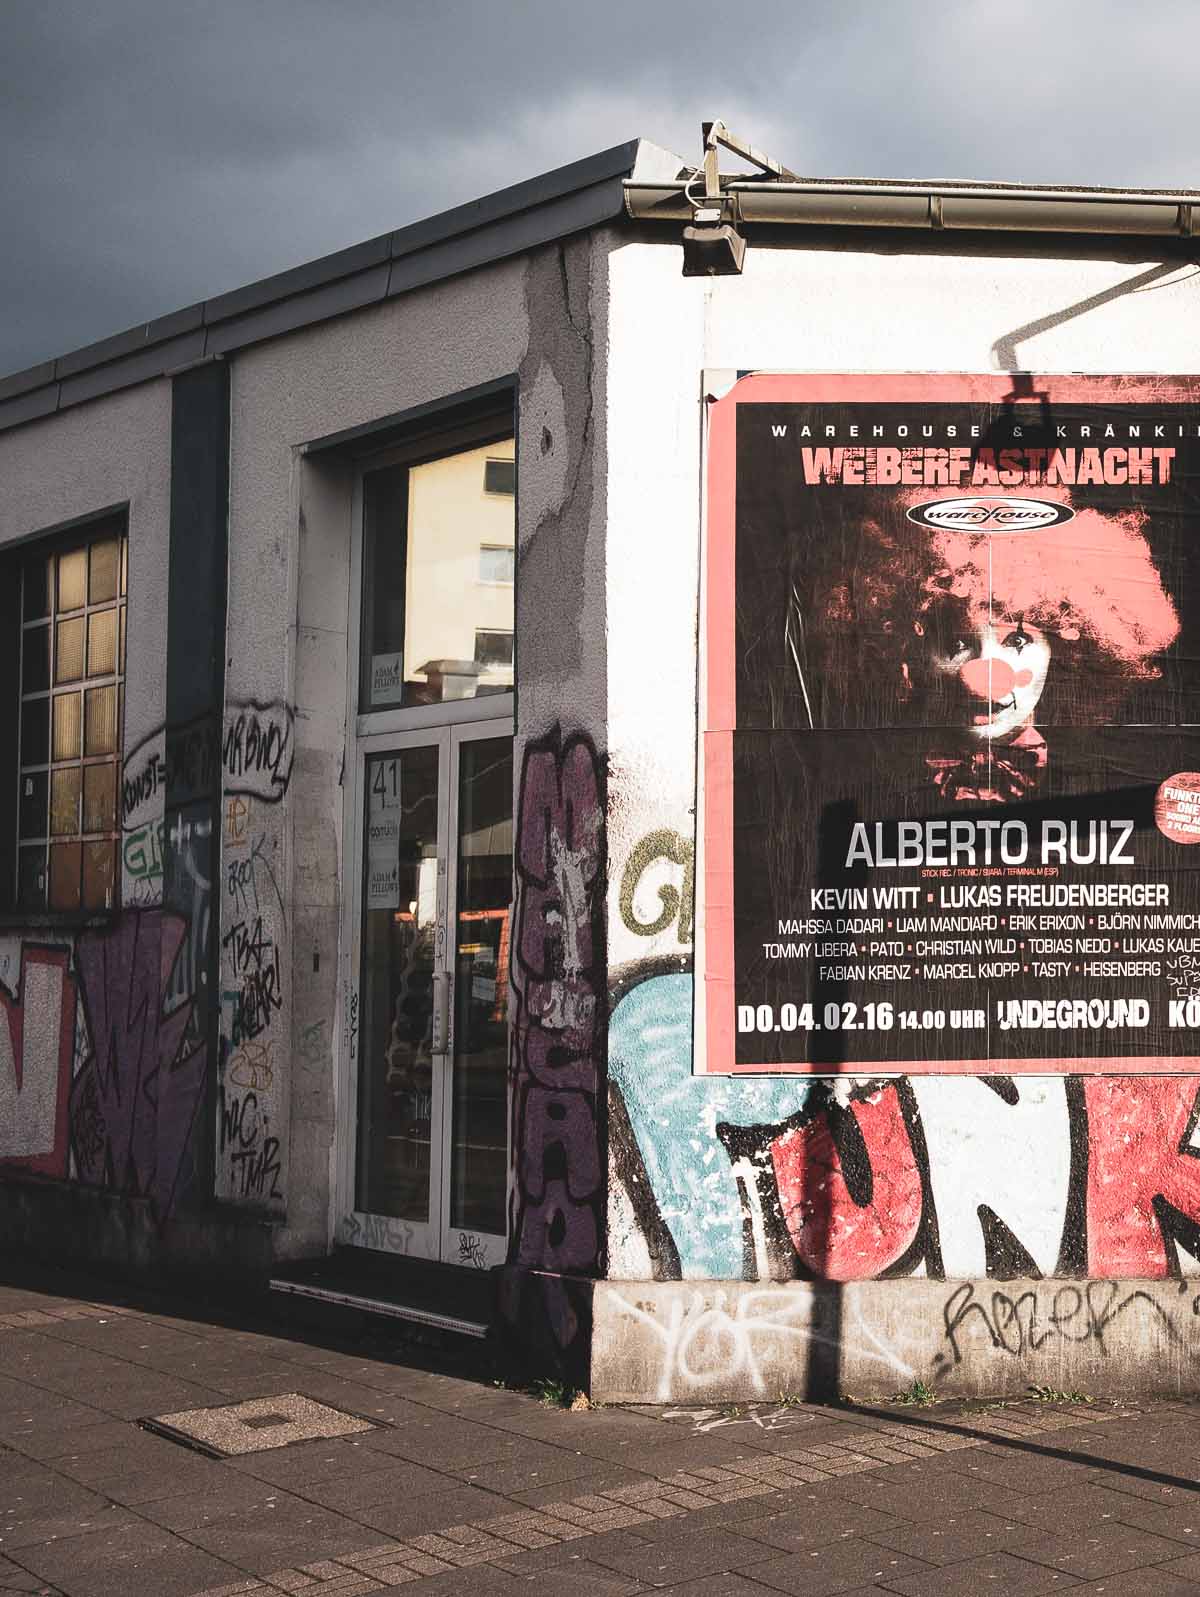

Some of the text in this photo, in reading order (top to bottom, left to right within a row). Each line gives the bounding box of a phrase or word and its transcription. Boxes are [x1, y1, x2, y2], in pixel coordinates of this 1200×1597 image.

[771, 425, 980, 438] WAREHOUSE
[1013, 426, 1023, 438] &
[801, 447, 1176, 485] WEIBERFASTNACHT
[1178, 802, 1200, 816] ONE
[845, 820, 1135, 868] ALBERTO RUIZ
[811, 883, 1169, 910] KEVIN WITT LUKAS FREUDENBERGER
[778, 919, 833, 934] MAHSSA
[836, 918, 884, 934] DADARI
[896, 917, 927, 933] LIAM
[1009, 915, 1037, 930] ERIK
[1039, 915, 1085, 930] ERIXON
[1098, 913, 1141, 930] BJÖRN
[1143, 914, 1200, 930] NIMMICH
[763, 943, 811, 959] TOMMY
[815, 942, 858, 958] LIBERA
[870, 941, 904, 957] PATO
[916, 940, 982, 956] CHRISTIAN
[985, 939, 1016, 954] WILD
[1028, 938, 1073, 954] TOBIAS
[1076, 938, 1111, 953] NEDO
[1122, 938, 1165, 953] LUKAS
[820, 961, 1161, 981] FABIAN KRENZ MARCEL KNOPP TASTY HEISENBERG
[898, 1010, 946, 1030] 14.00
[949, 1009, 986, 1029] UHR
